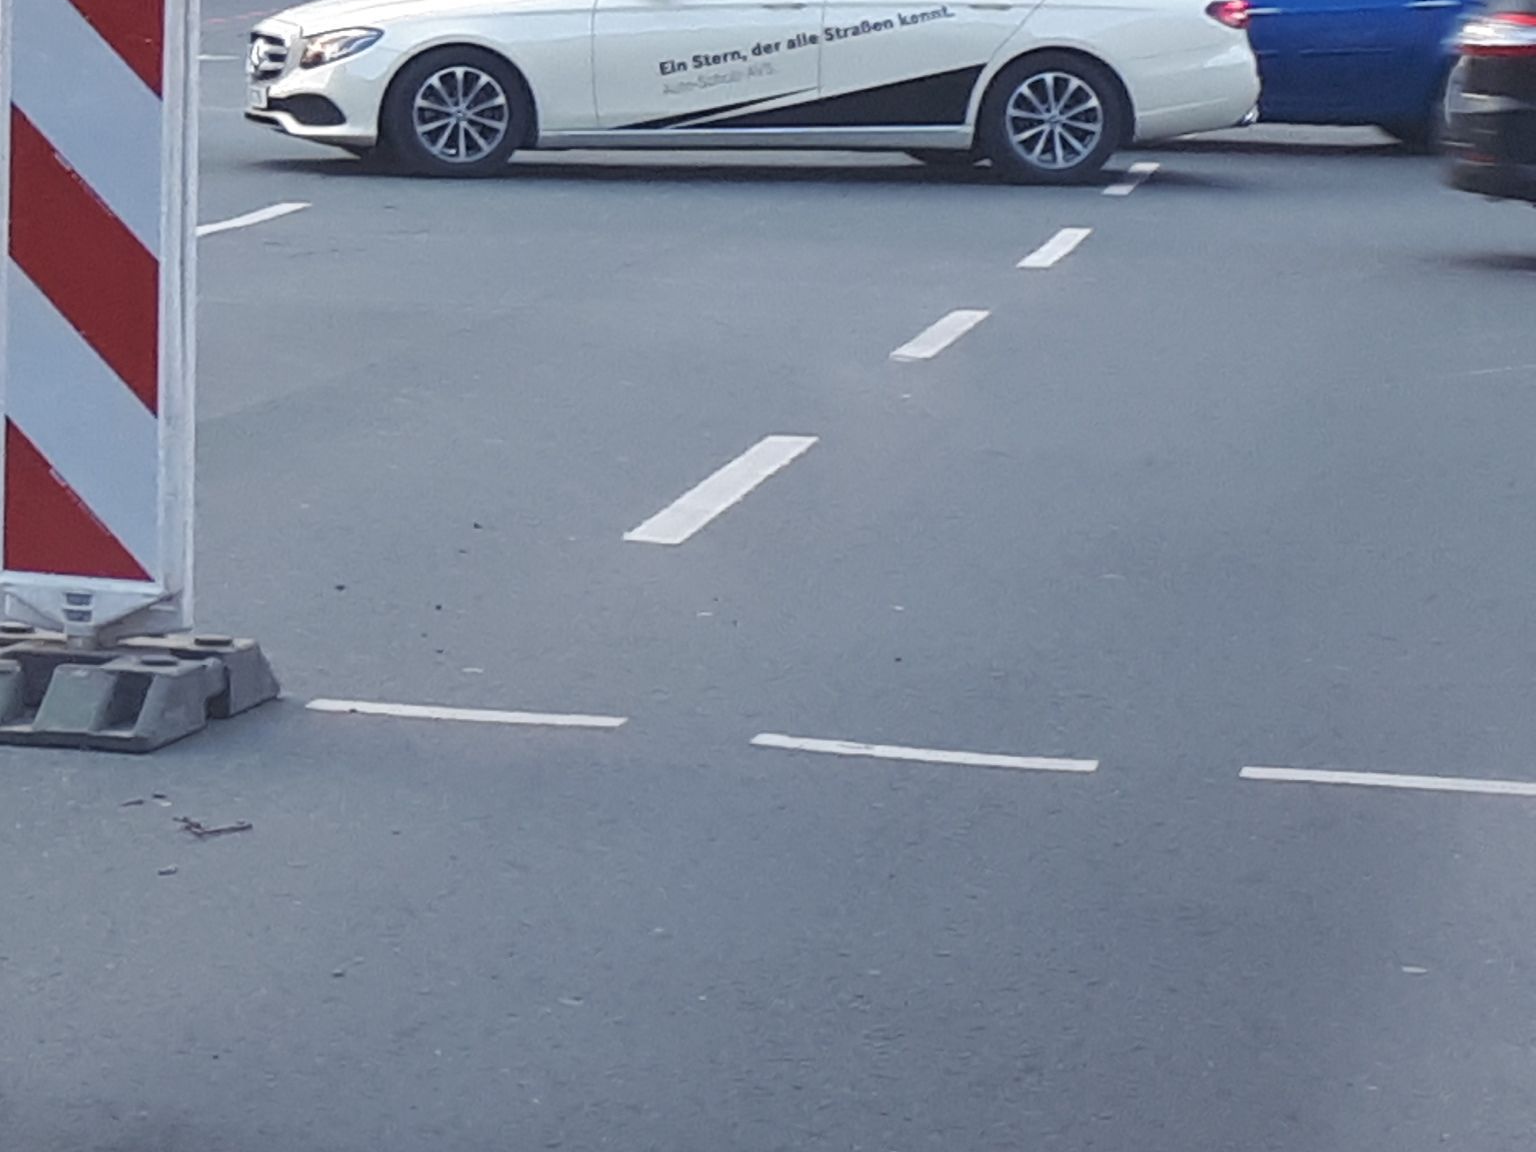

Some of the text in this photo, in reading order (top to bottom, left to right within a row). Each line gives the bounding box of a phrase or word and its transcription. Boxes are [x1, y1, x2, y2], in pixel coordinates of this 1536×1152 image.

[659, 59, 688, 76] Ein
[692, 50, 748, 69] Stern,
[751, 41, 782, 57] der
[786, 32, 819, 50] alle
[824, 19, 894, 41] Straßen
